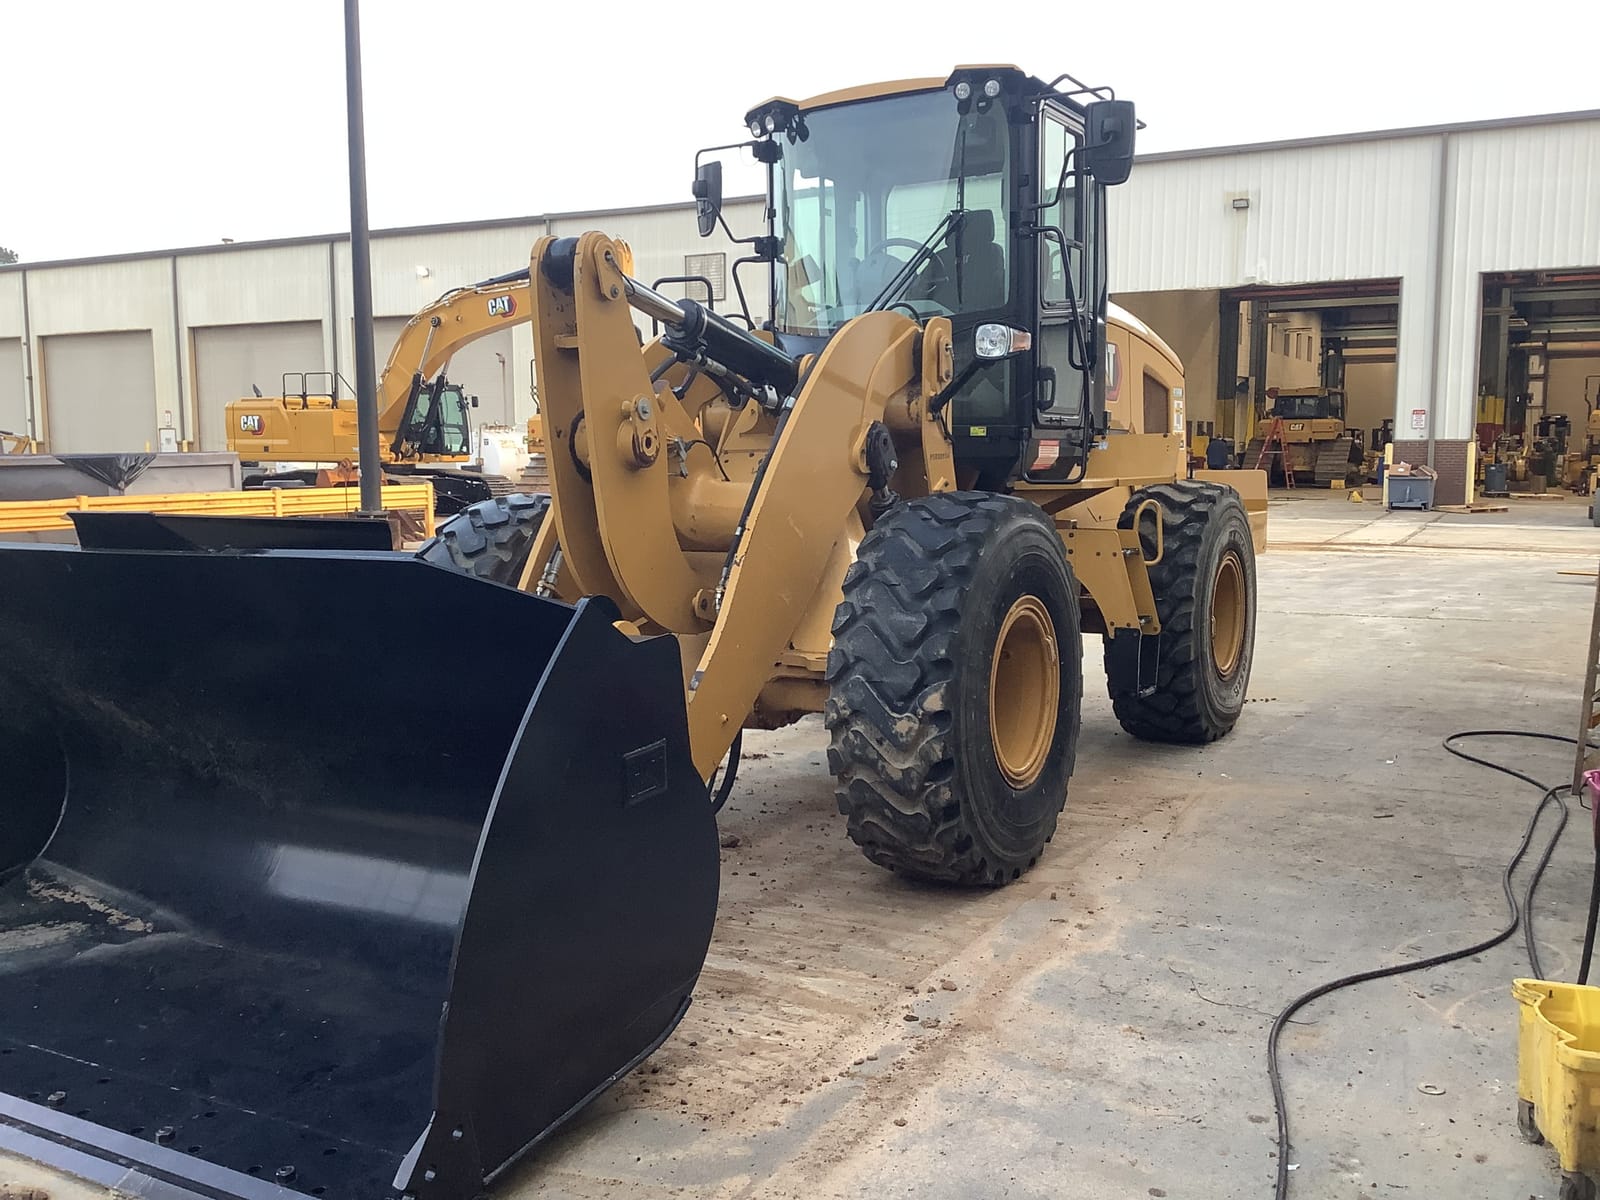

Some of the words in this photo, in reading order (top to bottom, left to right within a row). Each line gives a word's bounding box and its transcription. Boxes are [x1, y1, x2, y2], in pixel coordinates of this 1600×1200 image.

[488, 296, 510, 316] CAT
[240, 415, 260, 431] CAT
[1290, 422, 1303, 431] CAT
